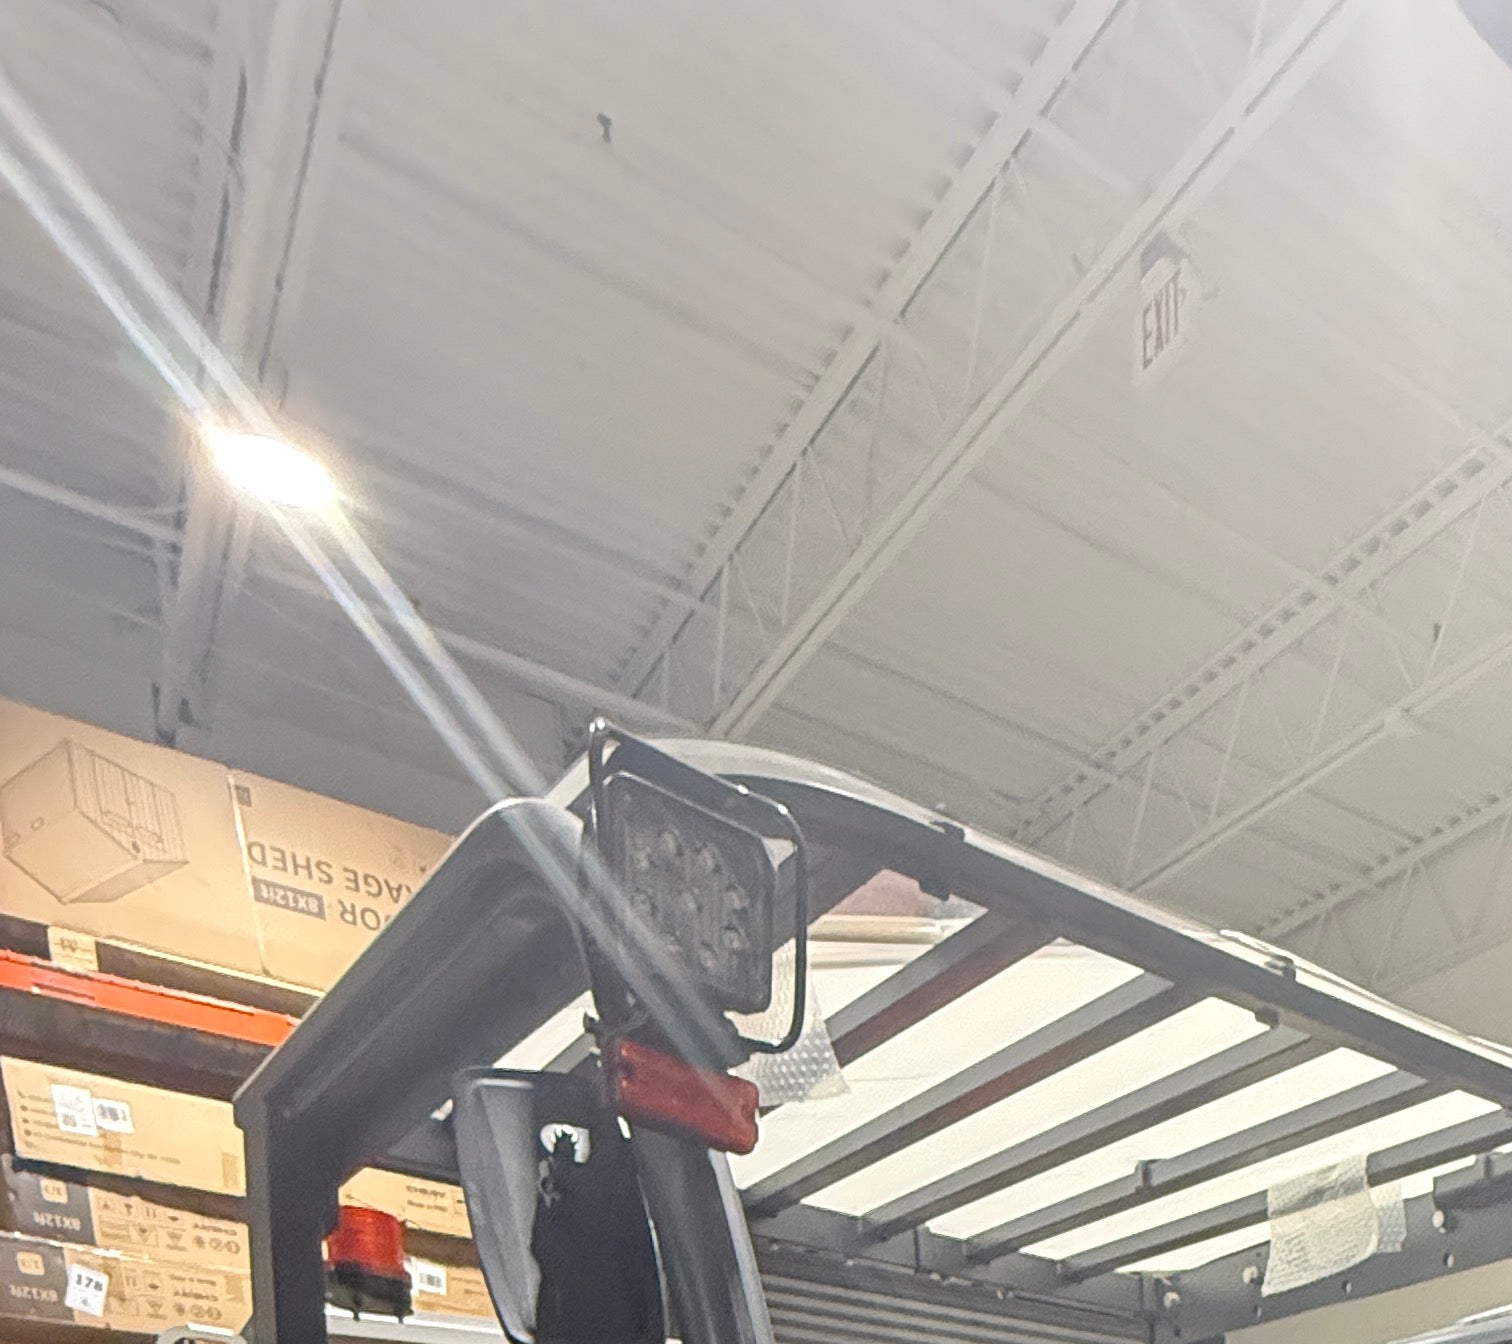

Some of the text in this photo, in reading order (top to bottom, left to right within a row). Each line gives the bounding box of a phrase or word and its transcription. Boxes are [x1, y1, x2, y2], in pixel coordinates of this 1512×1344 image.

[248, 840, 413, 905] AGE SHED
[337, 898, 390, 931] OR
